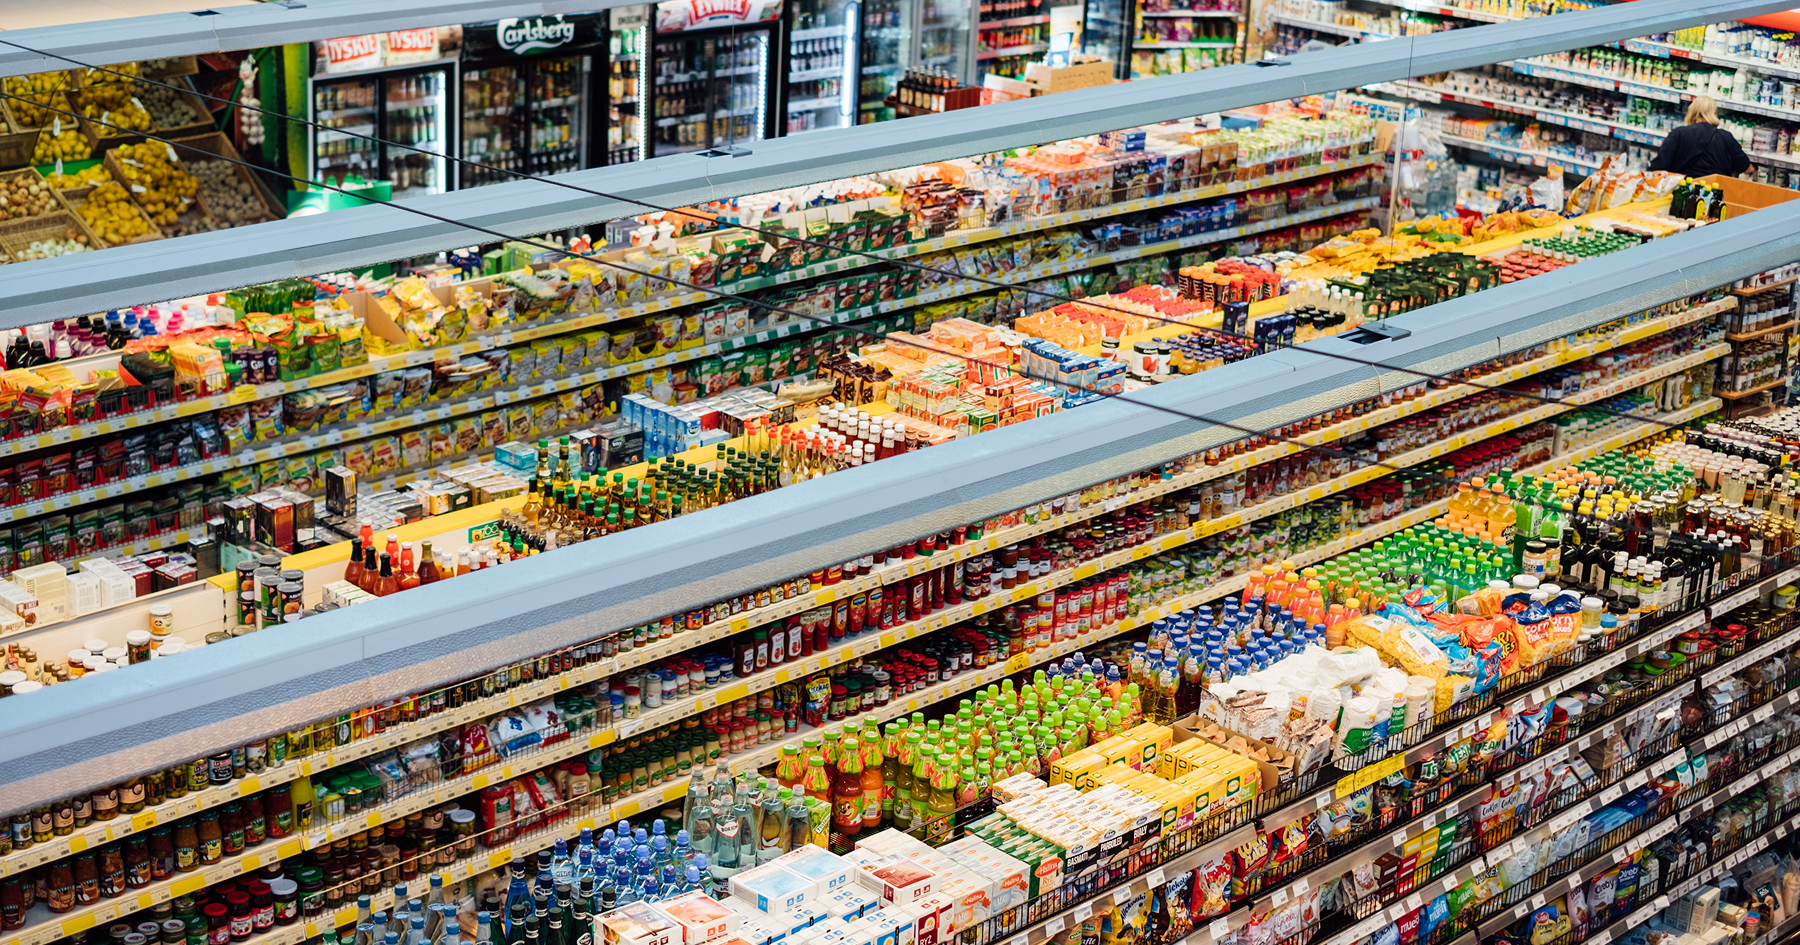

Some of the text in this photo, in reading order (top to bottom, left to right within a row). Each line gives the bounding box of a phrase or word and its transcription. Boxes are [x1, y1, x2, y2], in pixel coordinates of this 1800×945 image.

[388, 28, 434, 49] TYSKIE
[497, 15, 575, 50] Carlsberg
[327, 36, 378, 62] TYSKIE
[1525, 621, 1549, 634] corn
[1552, 615, 1572, 625] orn
[837, 756, 850, 772] K
[803, 773, 815, 789] K
[931, 770, 943, 787] K
[1082, 937, 1096, 945] afle
